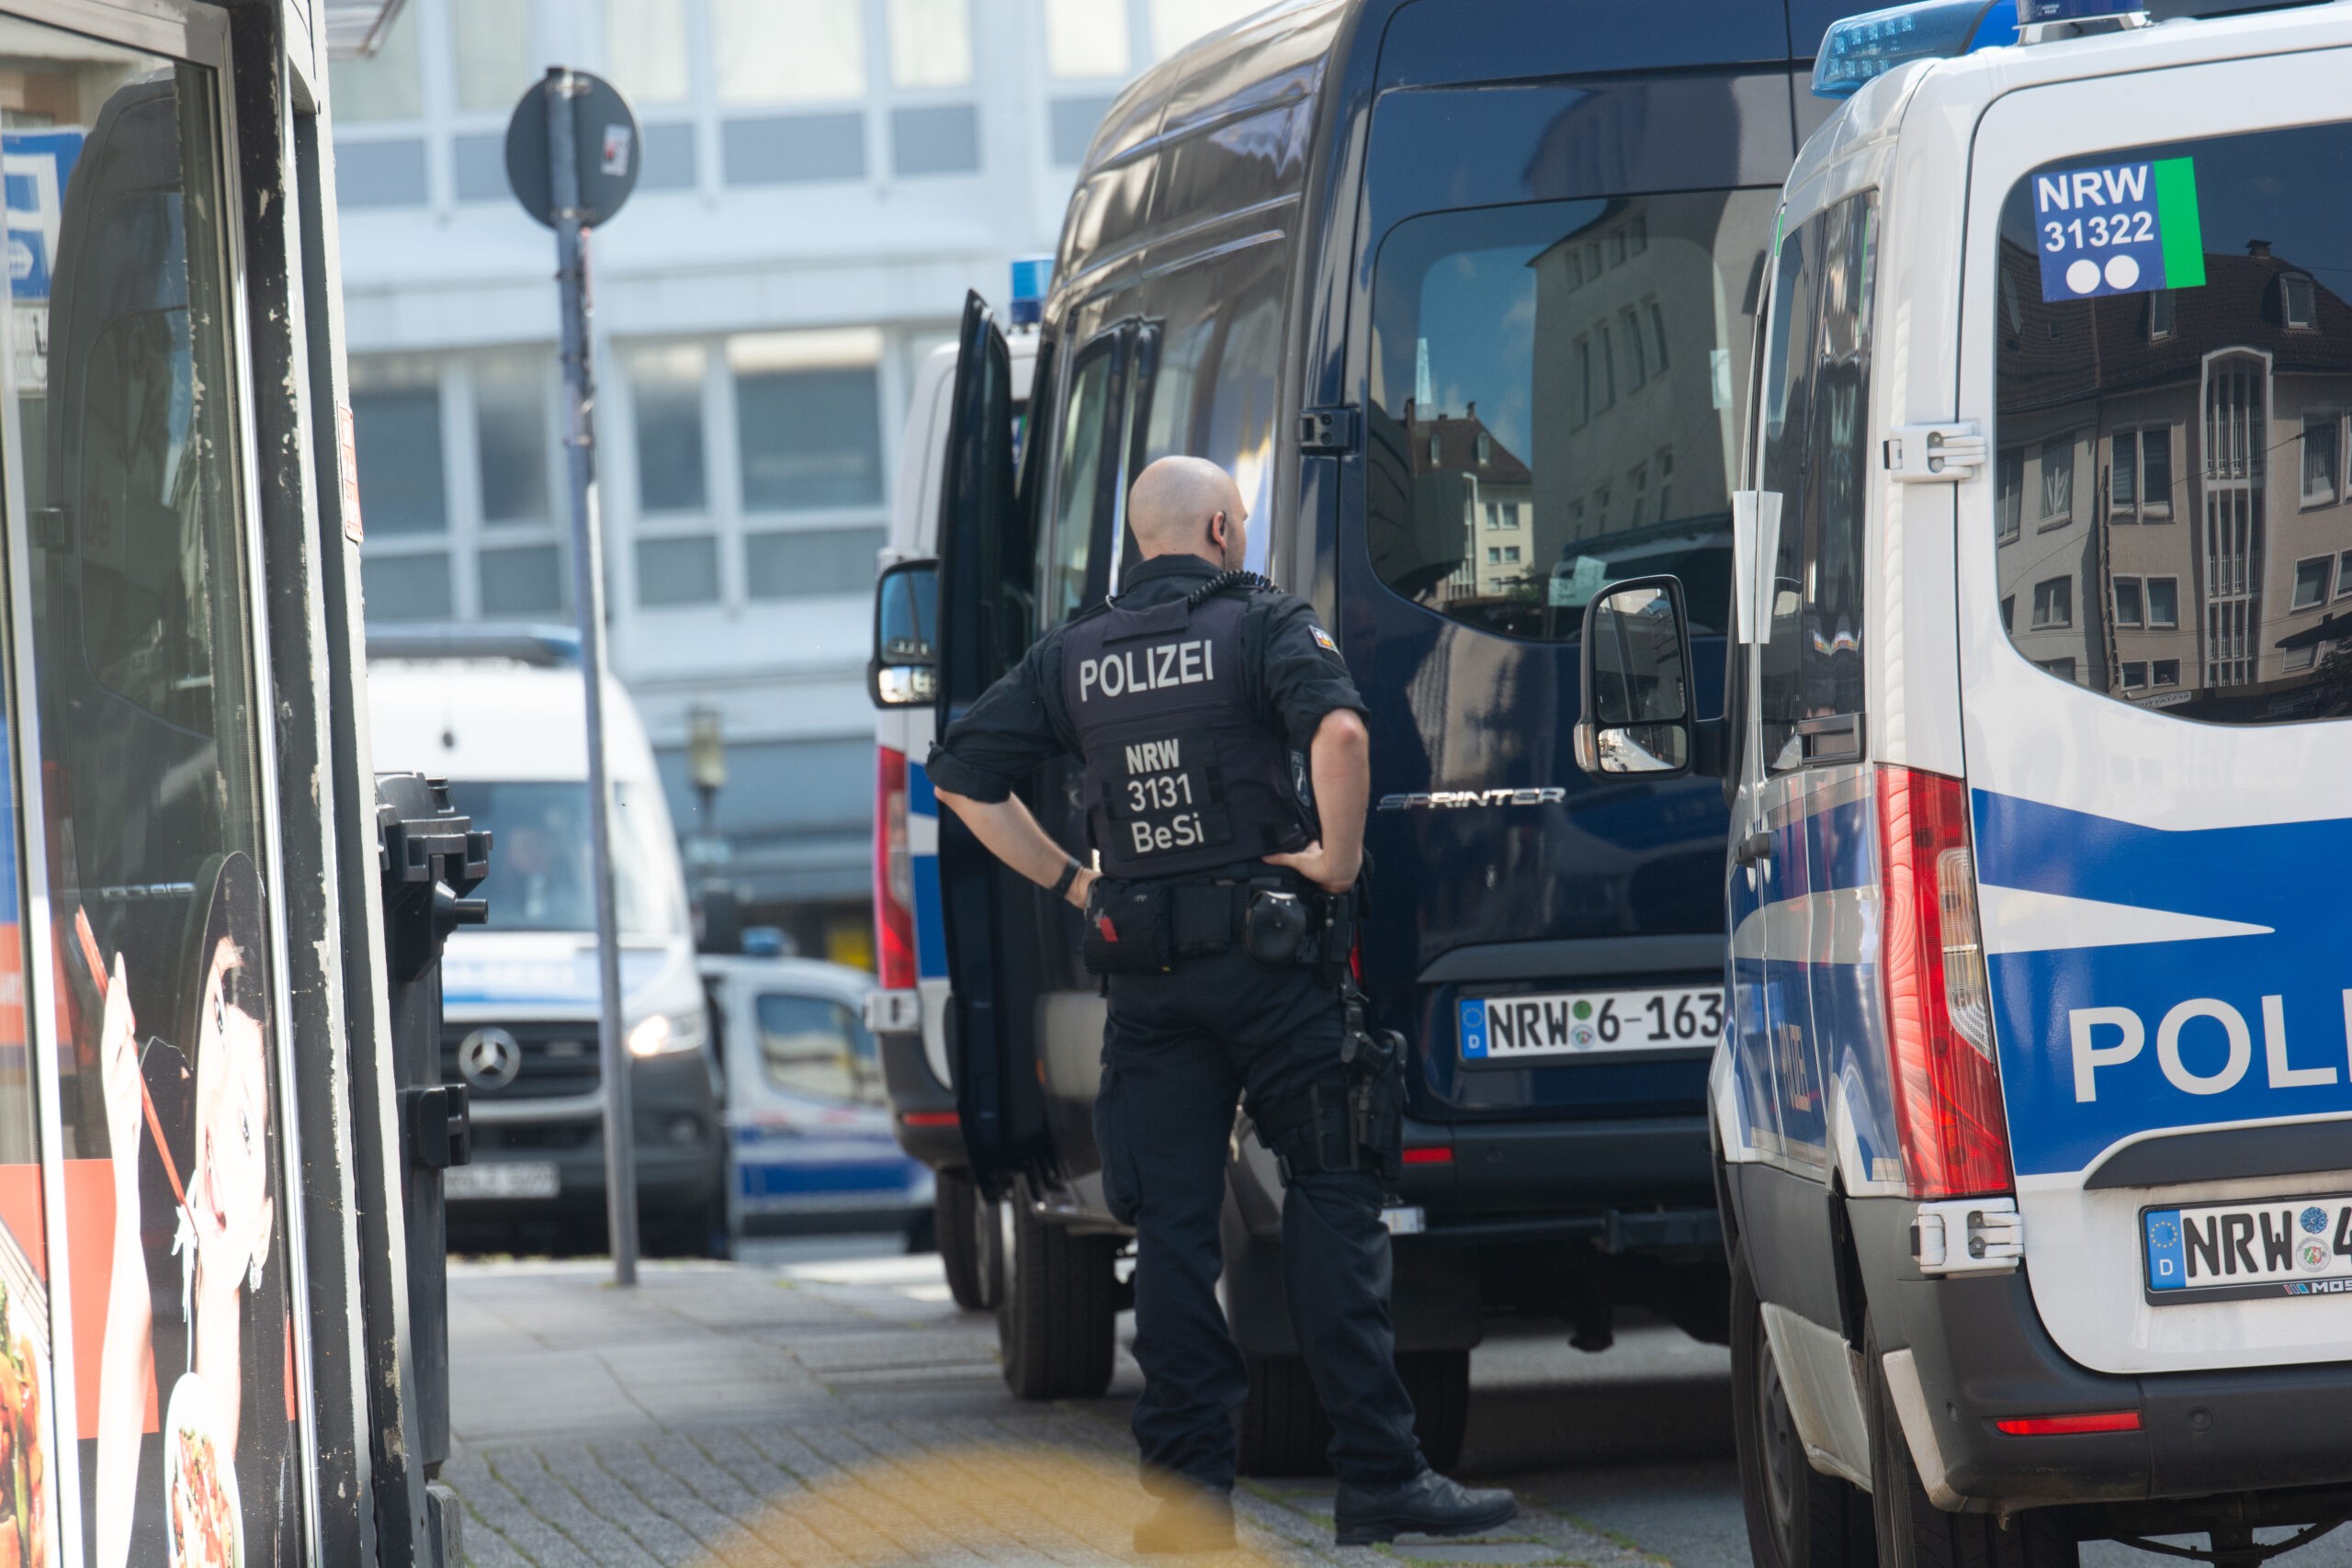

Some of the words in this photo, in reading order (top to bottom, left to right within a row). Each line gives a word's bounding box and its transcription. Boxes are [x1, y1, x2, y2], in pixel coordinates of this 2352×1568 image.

[2038, 165, 2148, 213] NRW
[2044, 211, 2154, 253] 31322
[1080, 639, 1214, 703] POLIZEI
[1125, 739, 1180, 774] NRW
[1127, 773, 1193, 812] 3131
[1376, 786, 1566, 810] SPRINTER
[1131, 812, 1204, 853] BeSi
[1468, 1034, 1480, 1049] D
[1488, 1001, 1567, 1049] NRW
[2183, 1211, 2292, 1278] NRW
[2160, 1258, 2174, 1276] D
